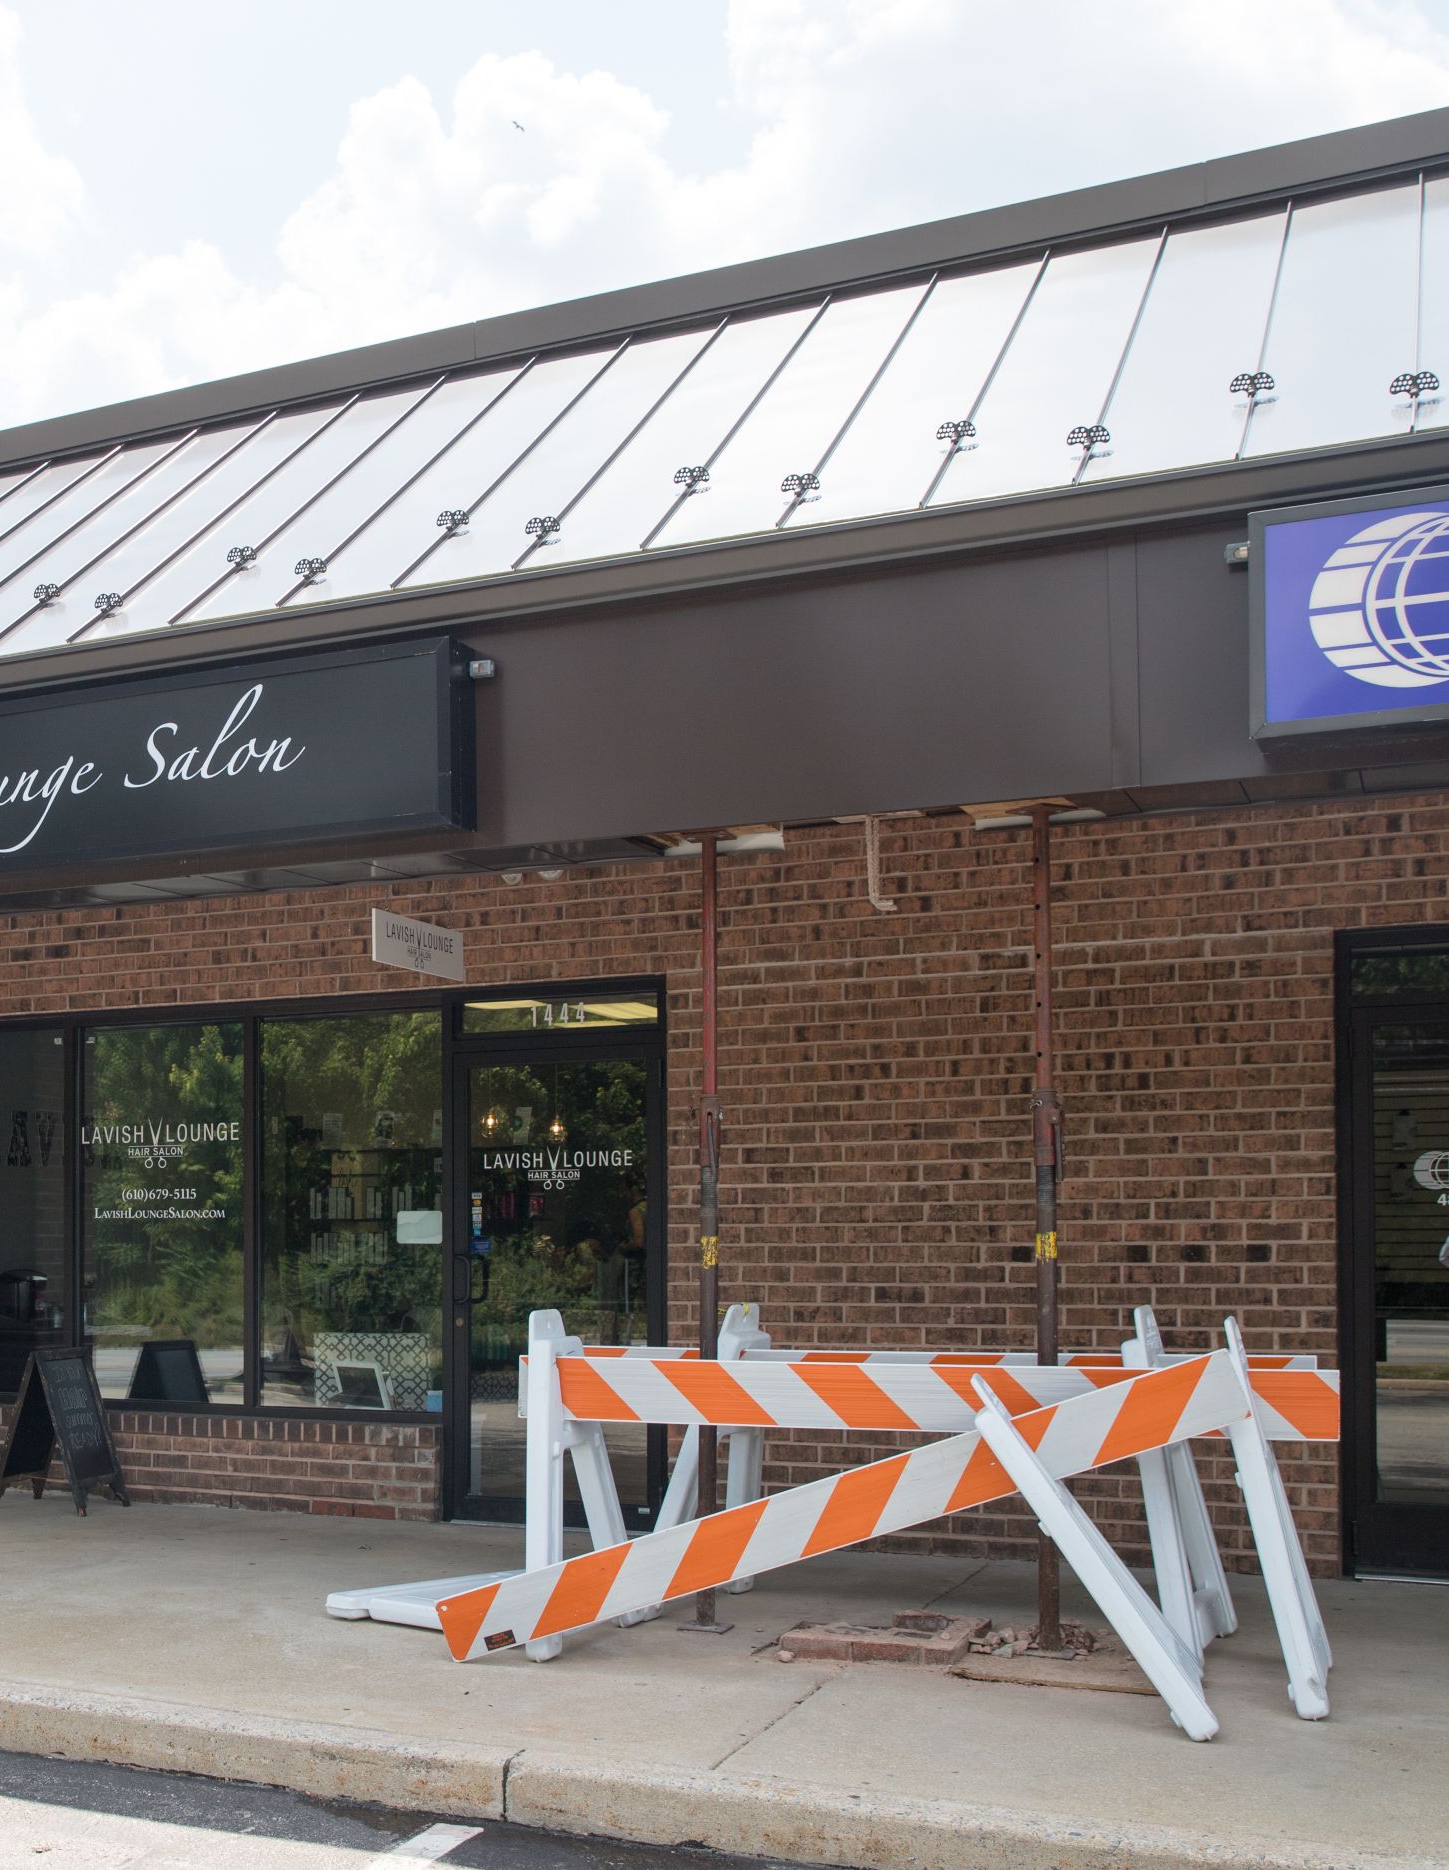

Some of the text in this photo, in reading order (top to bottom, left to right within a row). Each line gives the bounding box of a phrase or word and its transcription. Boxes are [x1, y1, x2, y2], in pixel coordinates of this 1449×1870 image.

[123, 684, 305, 788] Salon
[386, 921, 453, 954] LAVISH LOUNGE
[531, 1002, 585, 1027] 1444
[81, 1122, 239, 1144] LAVISH LOUNGE
[128, 1147, 183, 1156] HAIR SALON
[484, 1150, 633, 1169] LAVISH LOUNGE
[528, 1170, 580, 1179] HAIR SALON
[122, 1188, 197, 1202] (610)679-5115
